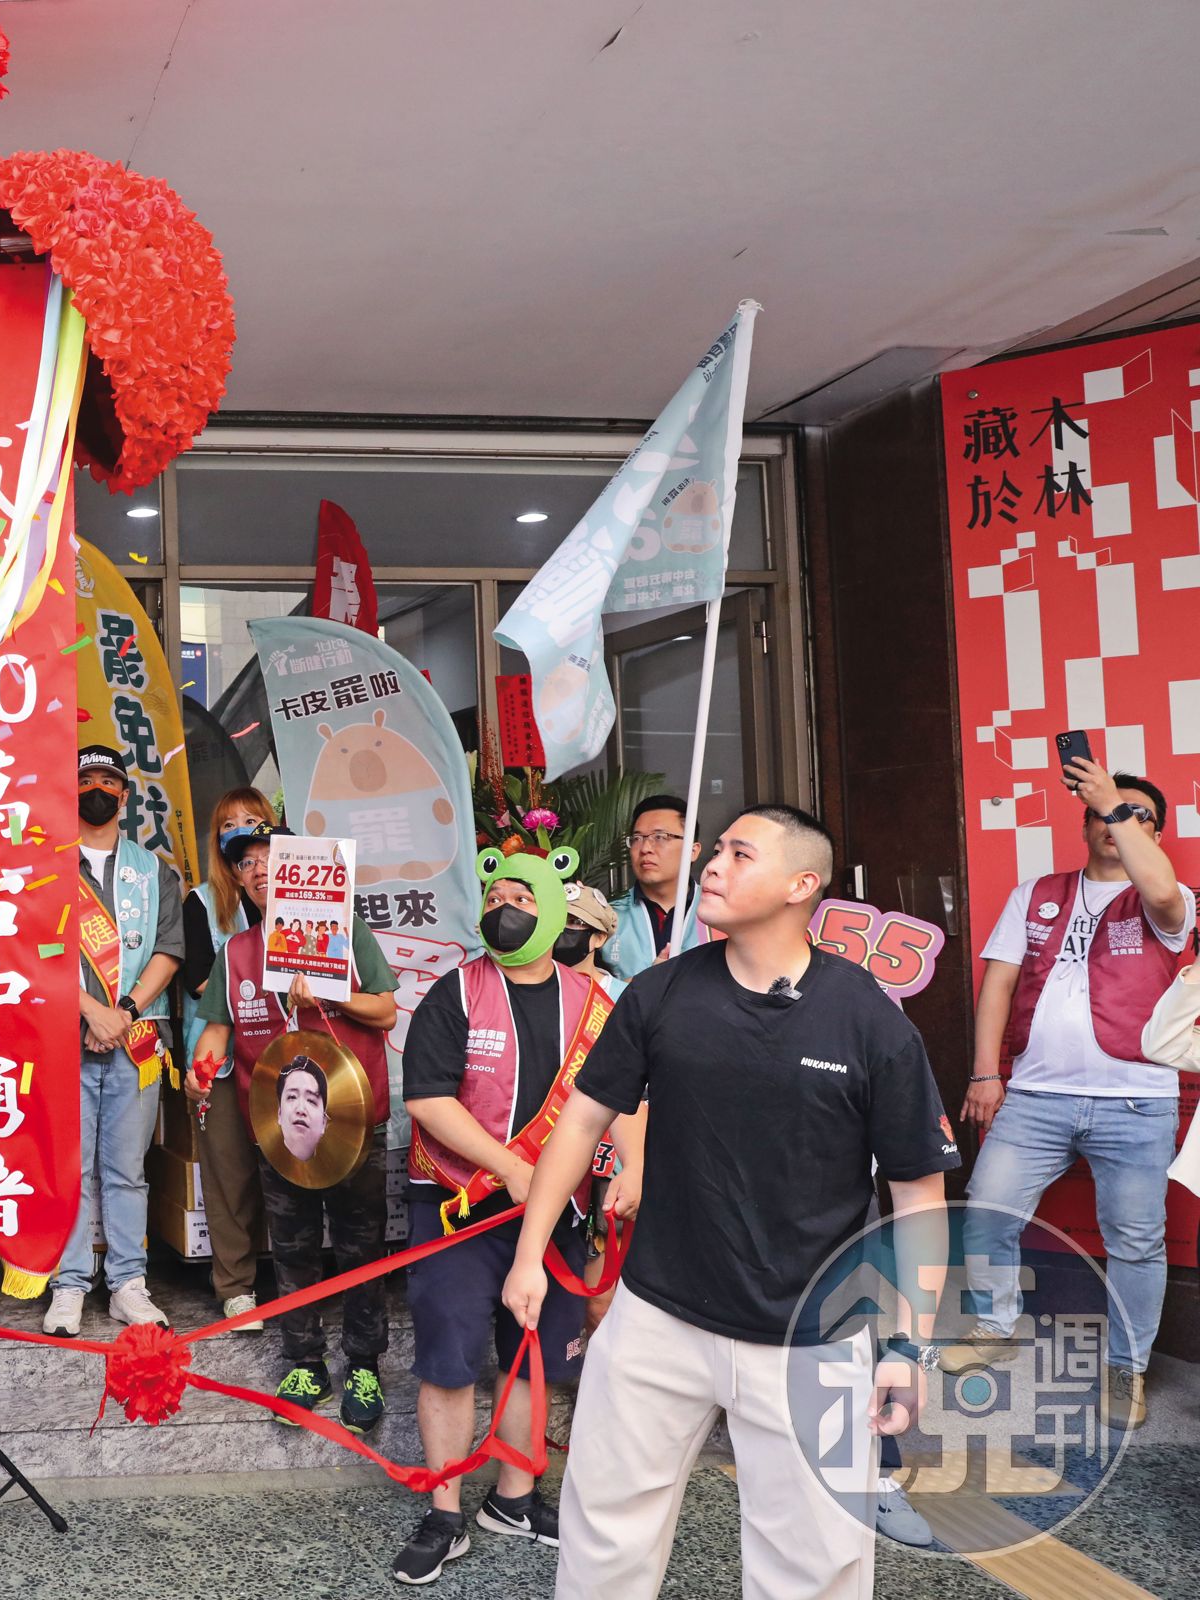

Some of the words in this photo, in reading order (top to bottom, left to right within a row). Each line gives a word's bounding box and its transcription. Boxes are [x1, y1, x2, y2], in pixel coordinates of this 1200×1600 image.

[962, 406, 1023, 529] 藏於
[1029, 396, 1093, 519] 木林
[274, 670, 401, 721] 卡皮罷啦
[275, 863, 346, 887] 46,276
